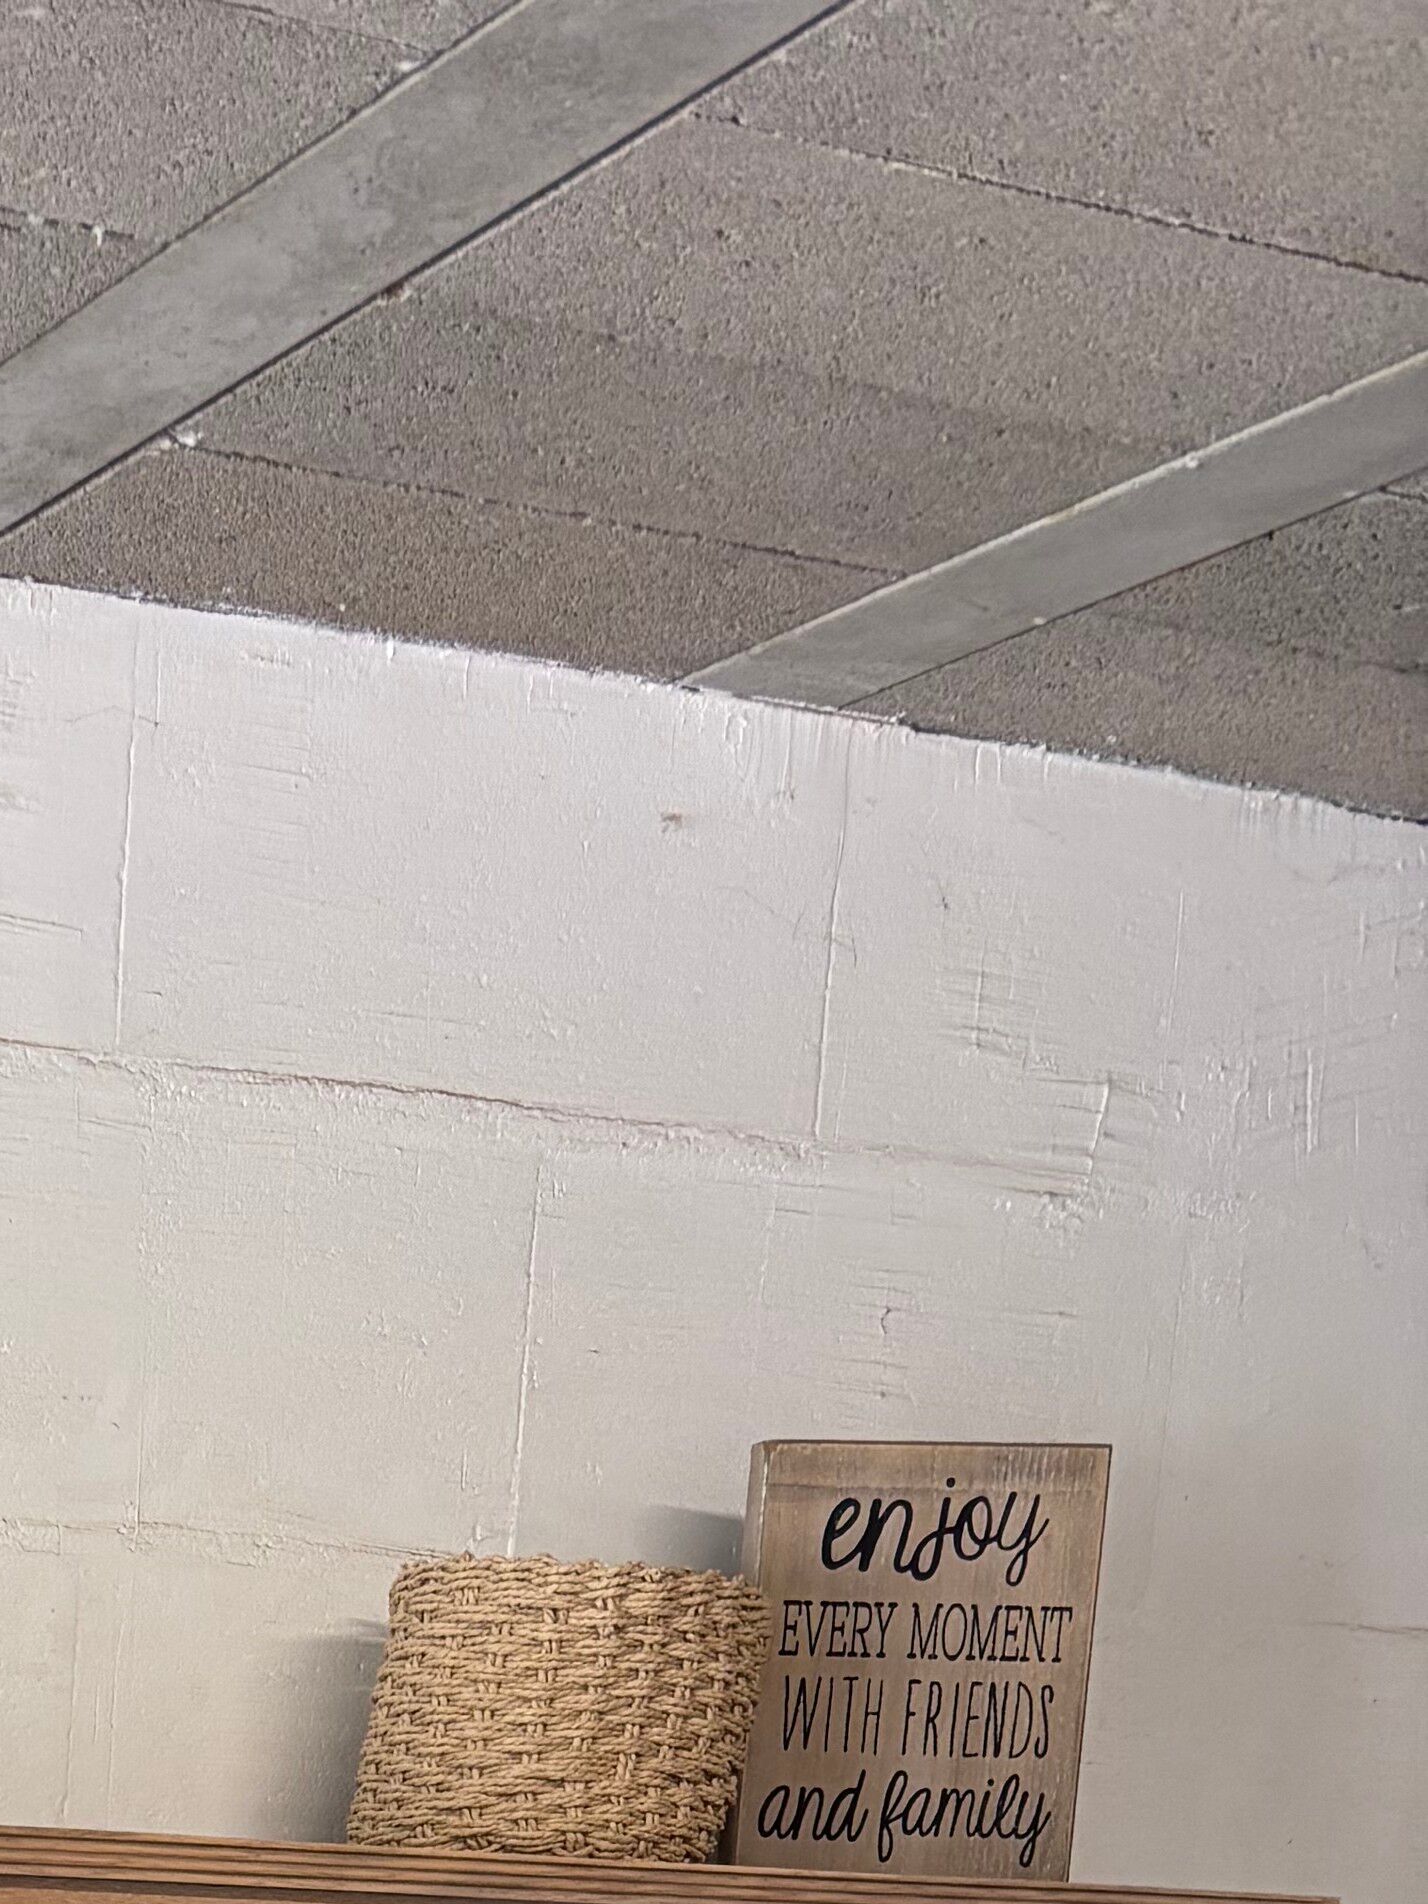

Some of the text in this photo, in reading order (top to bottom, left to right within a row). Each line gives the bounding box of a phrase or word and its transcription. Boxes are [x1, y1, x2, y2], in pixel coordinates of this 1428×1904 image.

[821, 1477, 1049, 1586] enjoy
[778, 1600, 1073, 1662] EVERY MOMENT
[782, 1675, 1054, 1759] WITH FRIENDS
[757, 1769, 1052, 1868] and family
